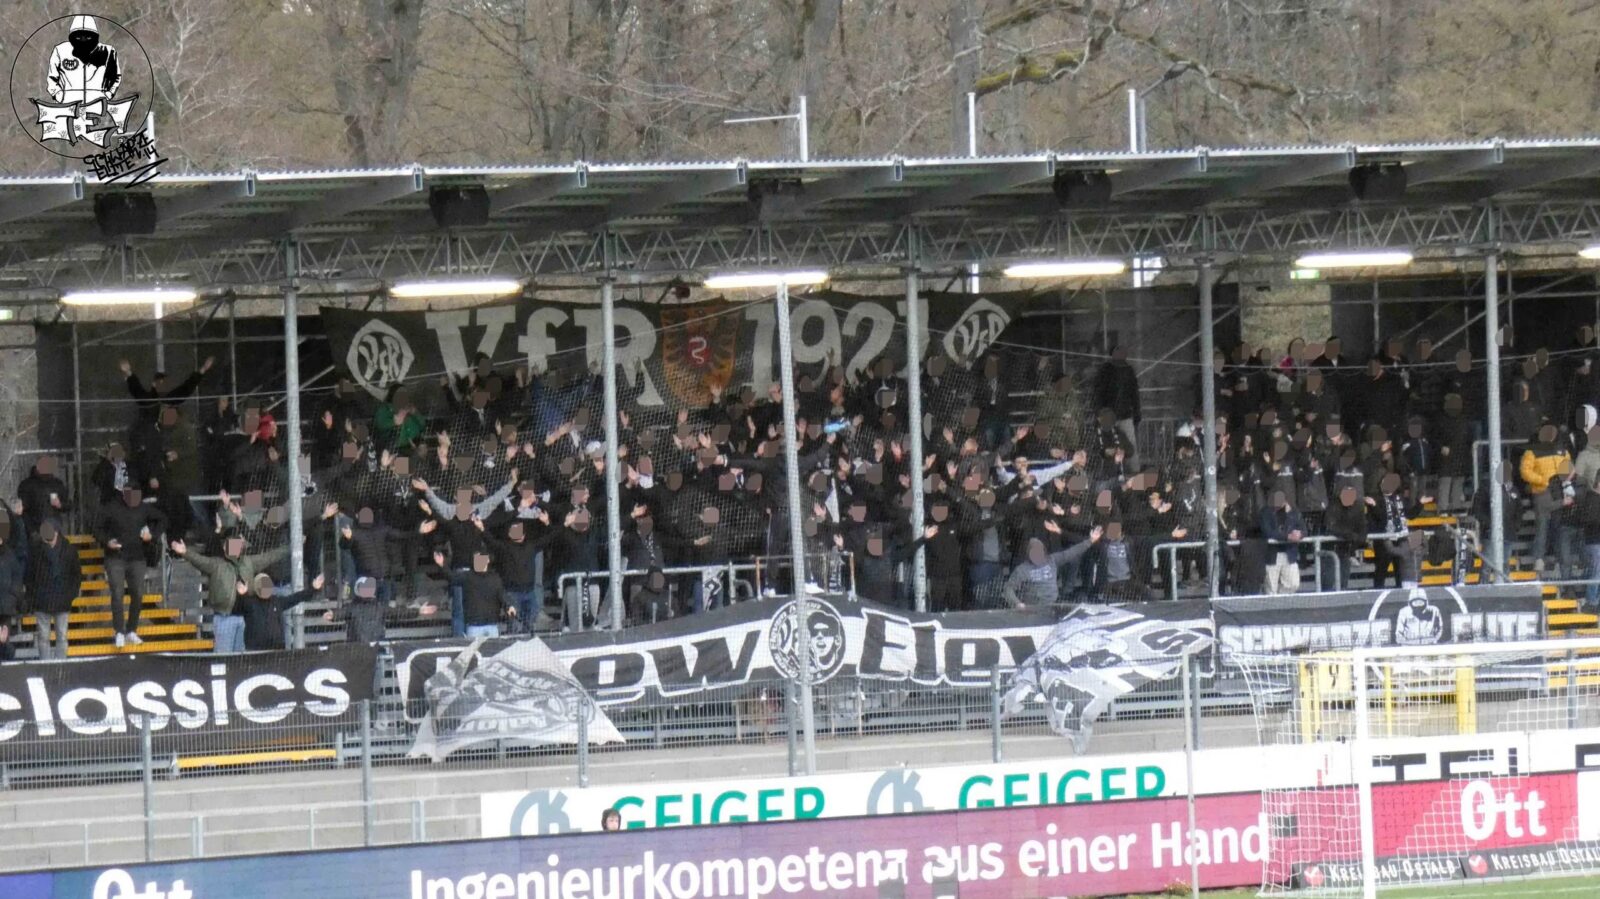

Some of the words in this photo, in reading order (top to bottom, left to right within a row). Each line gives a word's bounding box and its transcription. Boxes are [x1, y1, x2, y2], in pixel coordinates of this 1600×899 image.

[425, 305, 664, 406] VfR
[400, 629, 762, 722] Cew
[1460, 780, 1547, 840] Ott
[411, 846, 909, 899] Ingenieurkompetenz
[922, 842, 1005, 884] aus
[1018, 823, 1137, 878] einer
[1151, 812, 1268, 869] Hand
[1329, 864, 1398, 883] KREIBAU
